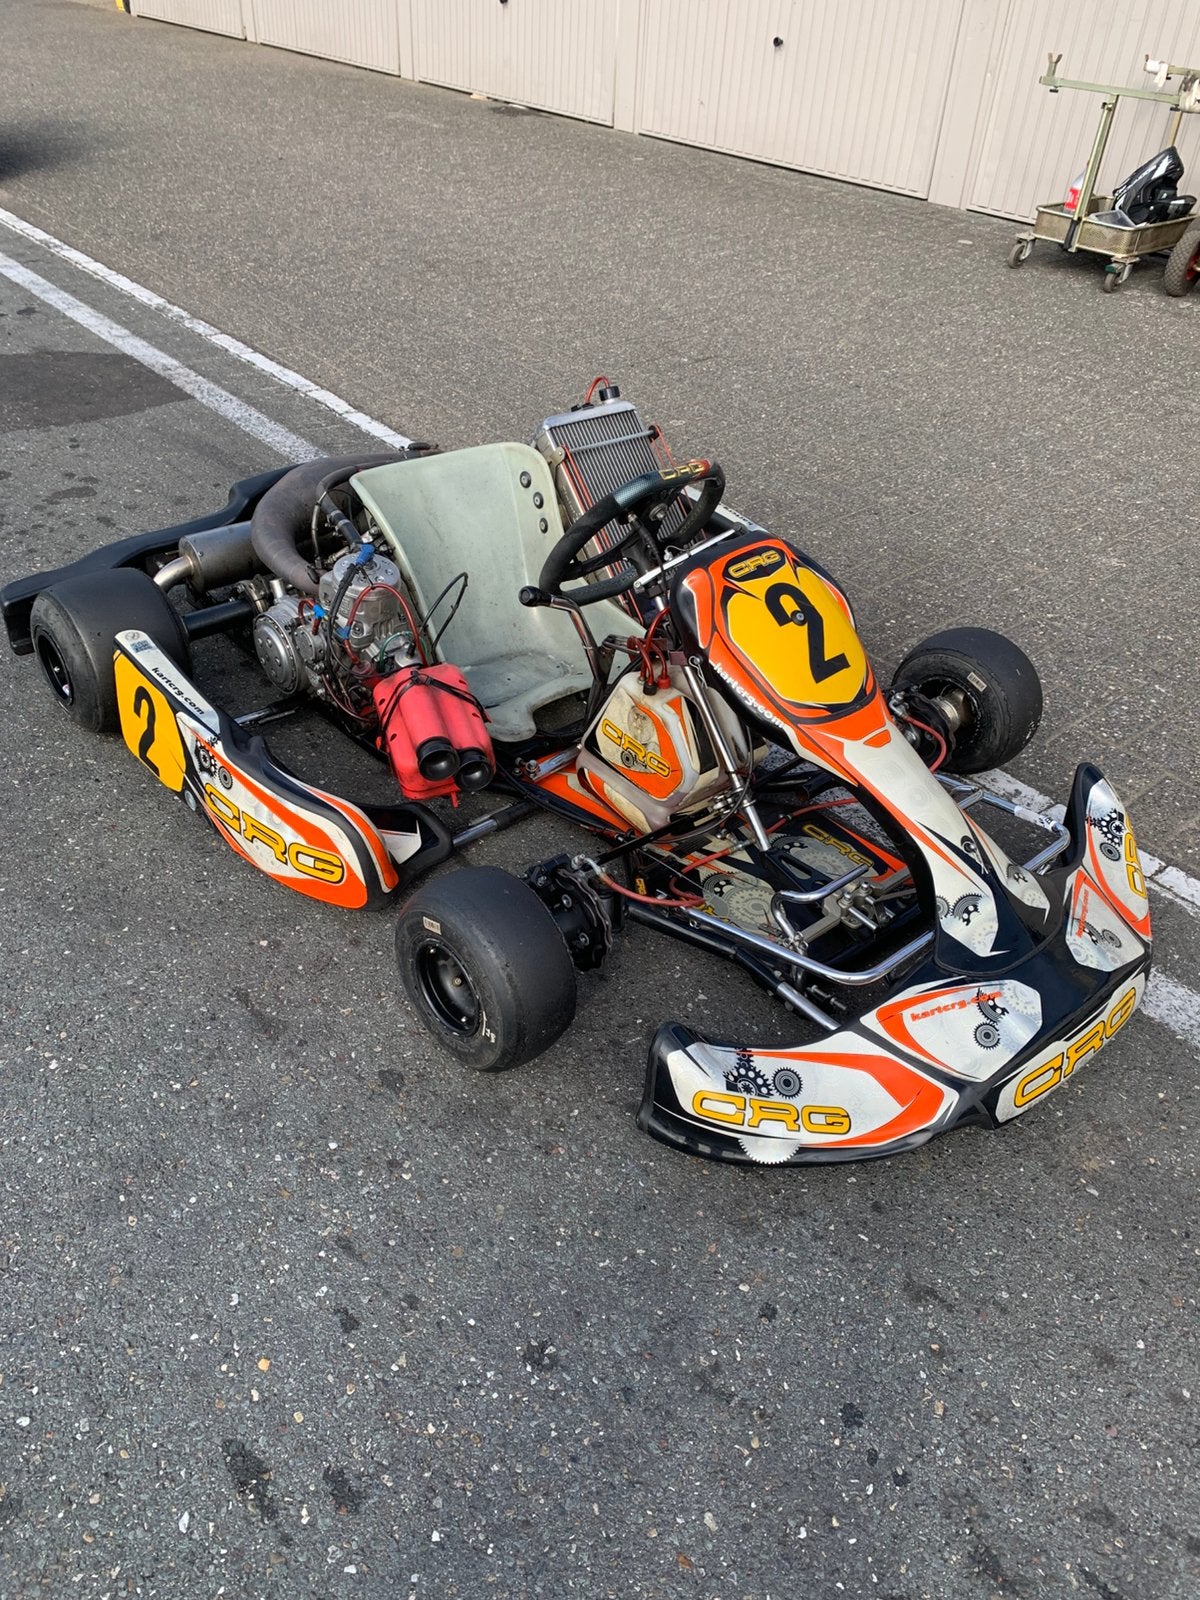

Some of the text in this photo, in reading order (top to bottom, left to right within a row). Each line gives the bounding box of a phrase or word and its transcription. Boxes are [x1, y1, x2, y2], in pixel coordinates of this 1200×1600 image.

[727, 549, 782, 580] CRG
[764, 582, 851, 684] 2
[151, 667, 205, 716] kartcrg.com
[133, 685, 160, 779] 2
[601, 718, 671, 778] CRG
[203, 782, 344, 884] CRG
[910, 991, 1003, 1022] kartcrg.com
[1012, 986, 1137, 1109] CRG
[691, 1088, 852, 1136] CRG
